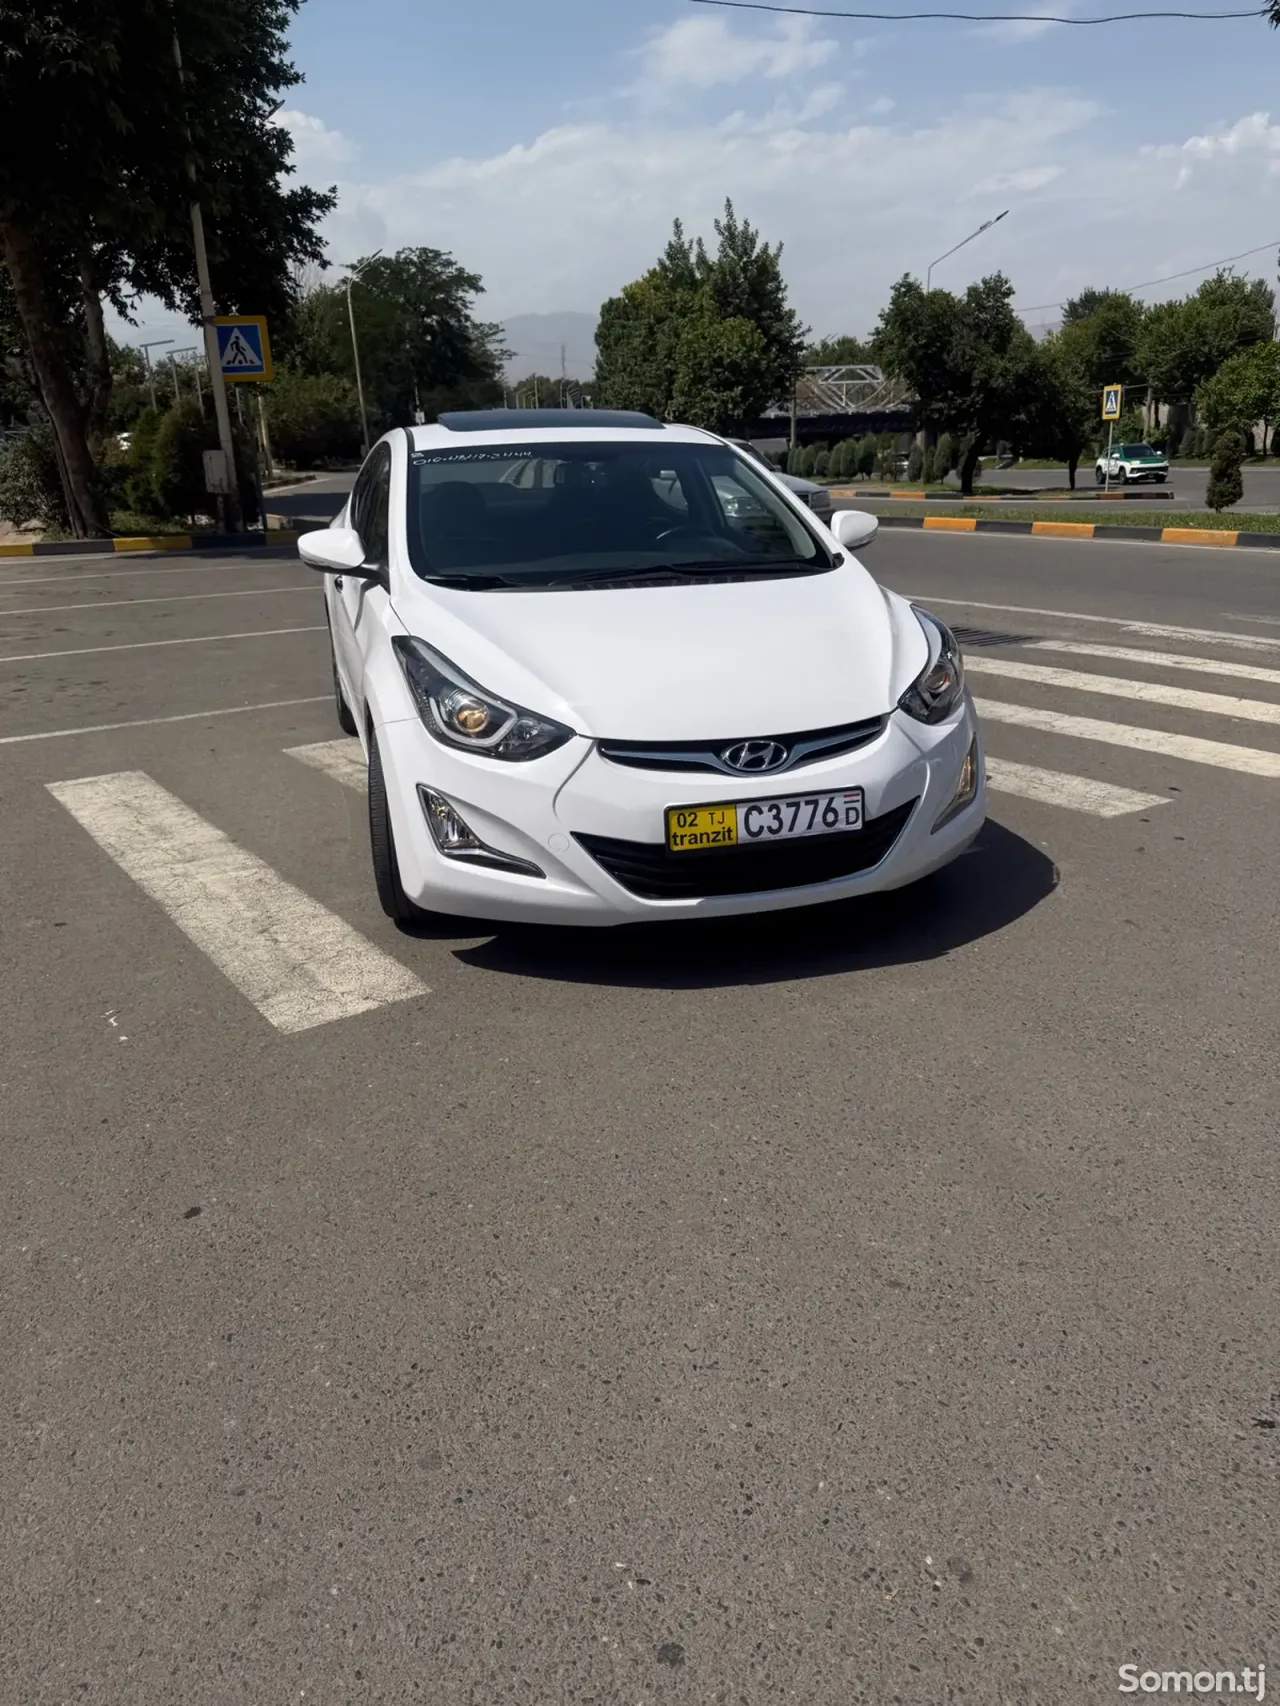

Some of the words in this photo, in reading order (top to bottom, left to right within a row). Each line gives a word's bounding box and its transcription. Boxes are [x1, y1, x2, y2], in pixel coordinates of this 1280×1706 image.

[676, 812, 698, 828] 02
[708, 811, 725, 825] TJ
[744, 797, 839, 838] C3776
[845, 806, 860, 826] D
[672, 826, 733, 846] tranzit
